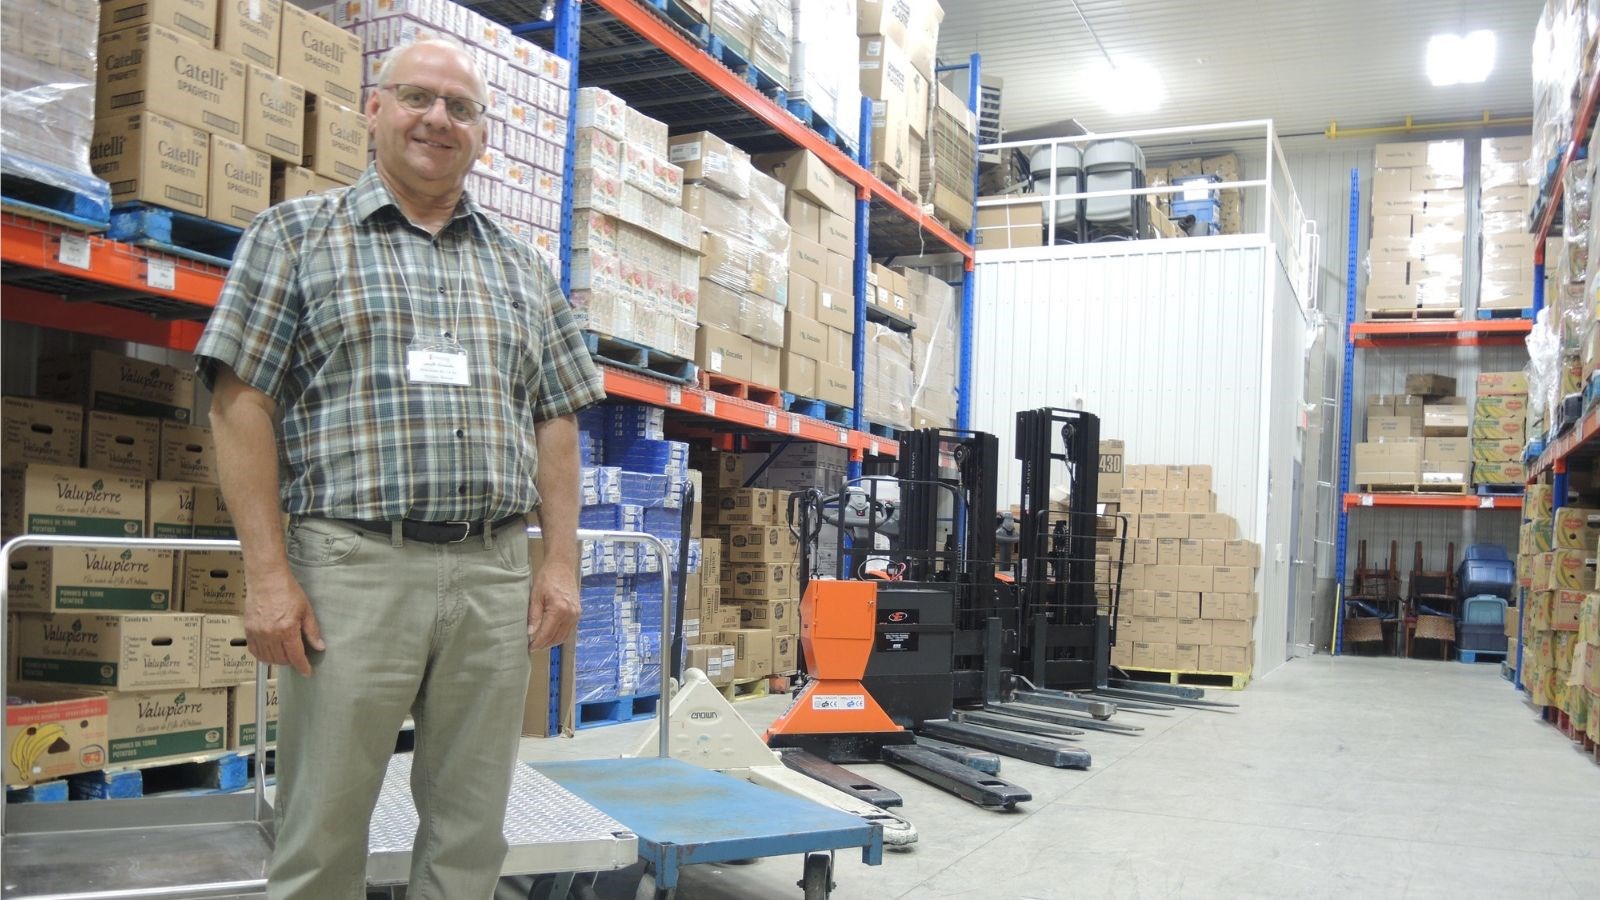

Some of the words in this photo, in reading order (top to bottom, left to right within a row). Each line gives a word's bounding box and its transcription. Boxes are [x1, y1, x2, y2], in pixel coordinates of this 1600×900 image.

[302, 31, 345, 63] Catelli
[106, 49, 142, 70] Catelli
[304, 52, 340, 74] SPAGHETTI
[174, 55, 226, 91] Catelli
[177, 79, 220, 104] SPAGHETTI
[260, 92, 297, 118] Catelli
[262, 110, 293, 127] SPAGHETTI
[329, 122, 362, 145] Catelli
[90, 136, 125, 160] atelli
[158, 140, 200, 167] Catelli
[161, 160, 196, 178] SPAGHETTI
[224, 163, 264, 188] Catelli
[227, 182, 259, 199] SPAGHETTI
[120, 366, 175, 392] Valupierre
[1099, 455, 1121, 472] 430
[57, 483, 122, 505] Valupierre
[85, 553, 149, 576] Valupierre
[203, 588, 236, 601] Valupierre
[43, 624, 98, 648] Valupierre
[144, 657, 180, 669] Valupierre
[138, 702, 202, 721] Valupierre
